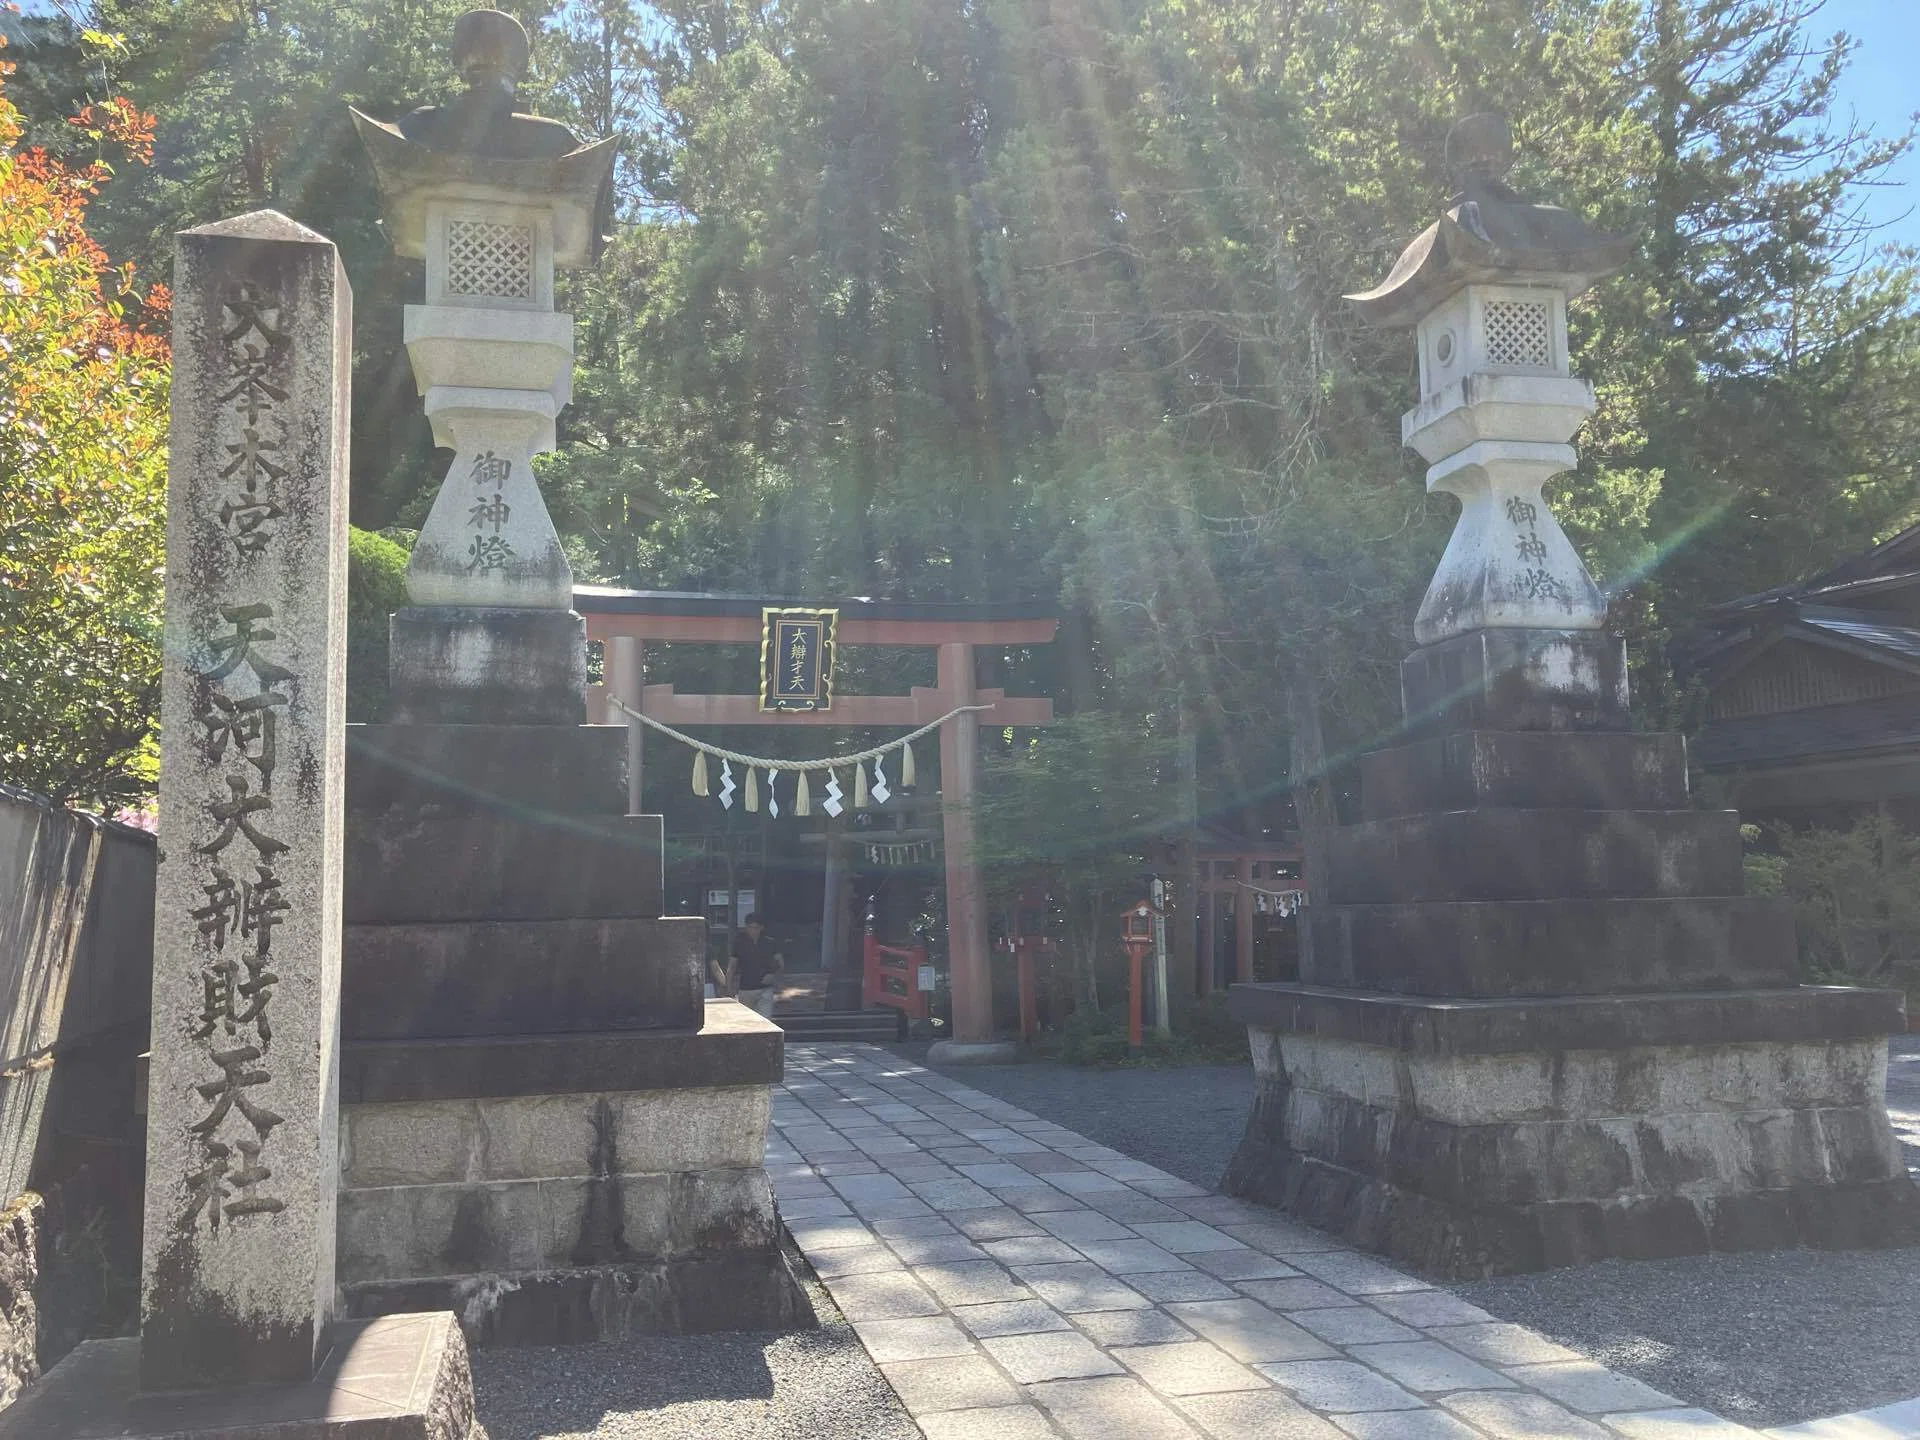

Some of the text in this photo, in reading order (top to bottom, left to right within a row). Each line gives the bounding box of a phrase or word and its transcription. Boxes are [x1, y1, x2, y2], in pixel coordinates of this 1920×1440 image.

[465, 450, 517, 573] 御神燈
[1505, 495, 1562, 600] 御神燈
[184, 602, 294, 1233] 天河大辨財天社
